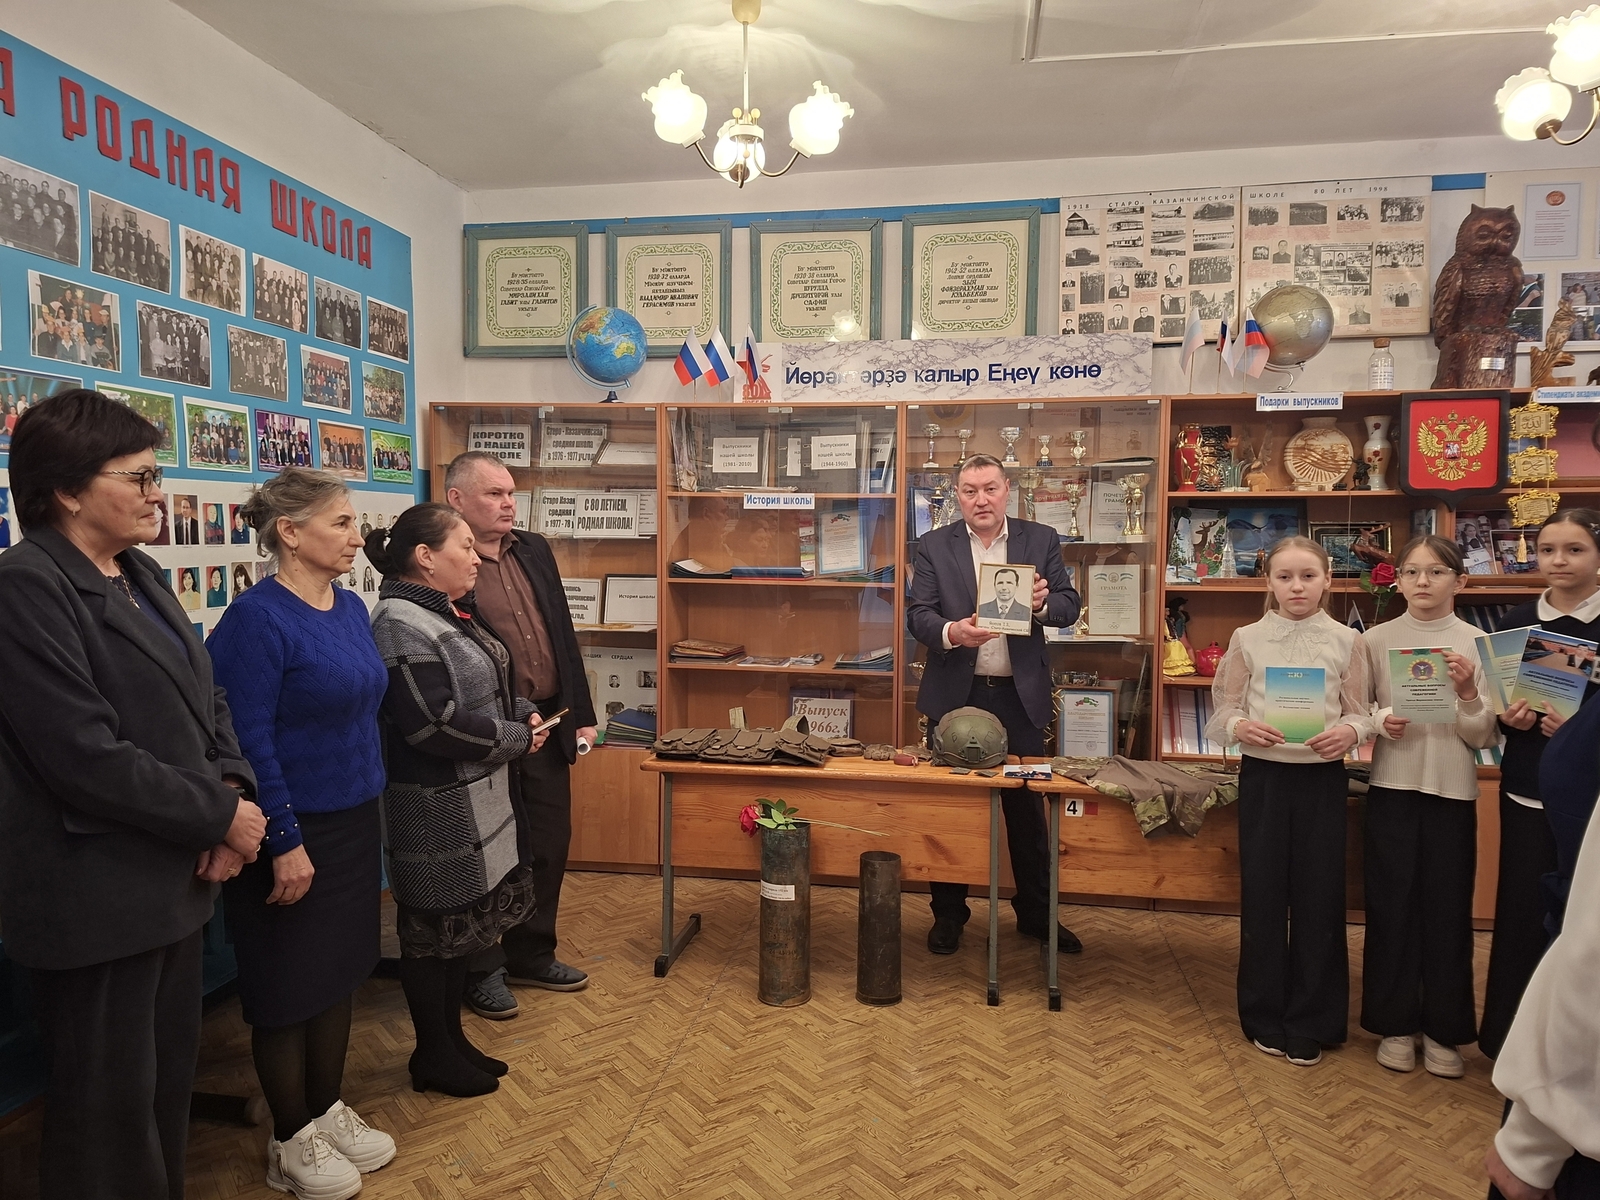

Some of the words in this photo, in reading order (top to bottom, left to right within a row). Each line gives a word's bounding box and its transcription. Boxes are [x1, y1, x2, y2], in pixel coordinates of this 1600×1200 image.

[59, 76, 242, 213] РОДНАЯ
[270, 178, 372, 269] ШКОЛА
[1152, 194, 1235, 204] КАЗАНЧИНСКОЙ
[914, 368, 980, 386] калыр
[988, 363, 1040, 384] Еңеү
[1050, 364, 1102, 379] көнө
[1260, 396, 1289, 409] Подарки
[1293, 398, 1339, 408] выпускников
[472, 432, 525, 440] КОРОТКО
[484, 441, 525, 450] НАШЕЙ
[552, 440, 575, 449] средняя
[576, 441, 594, 449] школа
[484, 451, 522, 460] КОЛЕ
[567, 452, 578, 461] 1977
[820, 460, 849, 468] (1944-1960)
[543, 496, 559, 505] Старо
[746, 494, 781, 507] История
[784, 496, 812, 505] школы
[584, 498, 590, 512] С
[590, 498, 600, 511] 80
[600, 498, 628, 513] ЛЕТИЕМ,
[548, 508, 572, 517] средняя
[550, 520, 561, 528] 1977
[564, 520, 571, 528] 78
[577, 516, 604, 531] РОДНАЯ
[606, 516, 633, 530] ШКОЛА!
[798, 704, 848, 719] Выпуск
[1067, 801, 1078, 815] 4
